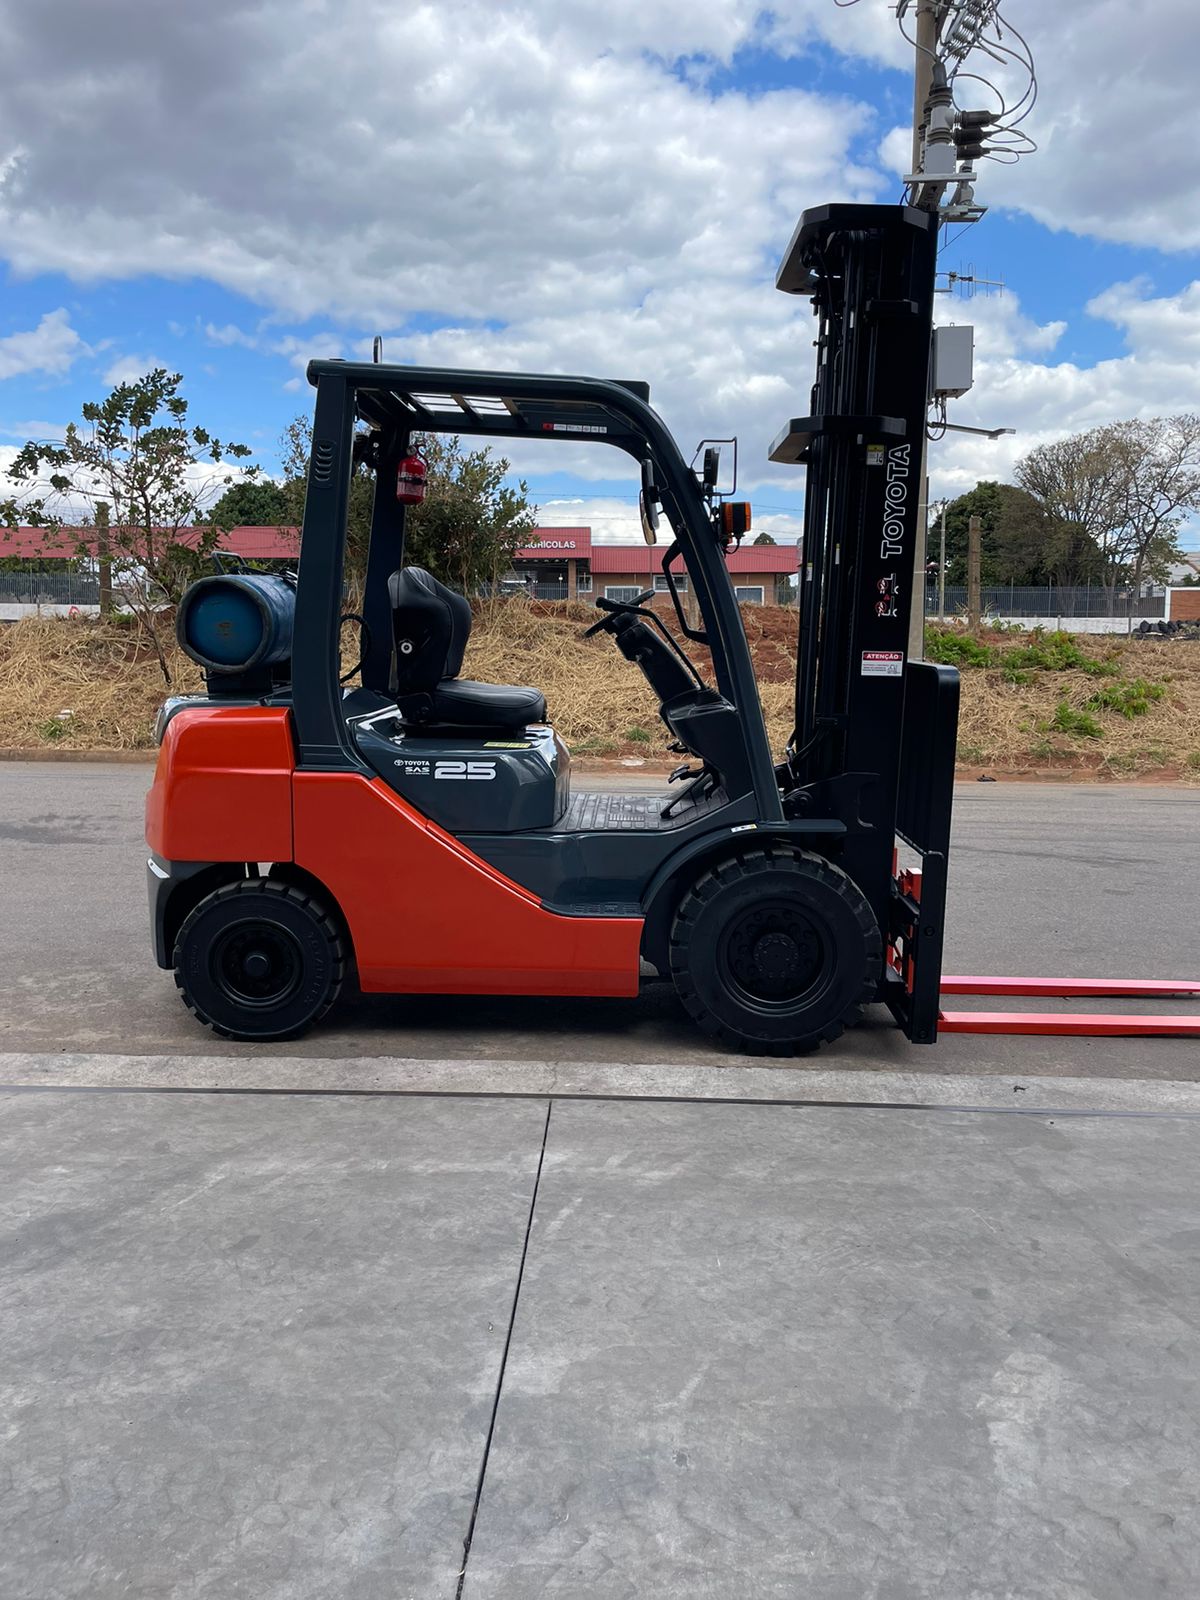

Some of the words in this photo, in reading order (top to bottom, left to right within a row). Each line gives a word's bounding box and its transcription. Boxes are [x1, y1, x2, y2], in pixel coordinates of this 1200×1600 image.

[881, 443, 911, 559] TOYOTA
[866, 652, 899, 660] ATENÇÃO
[434, 761, 497, 780] 25
